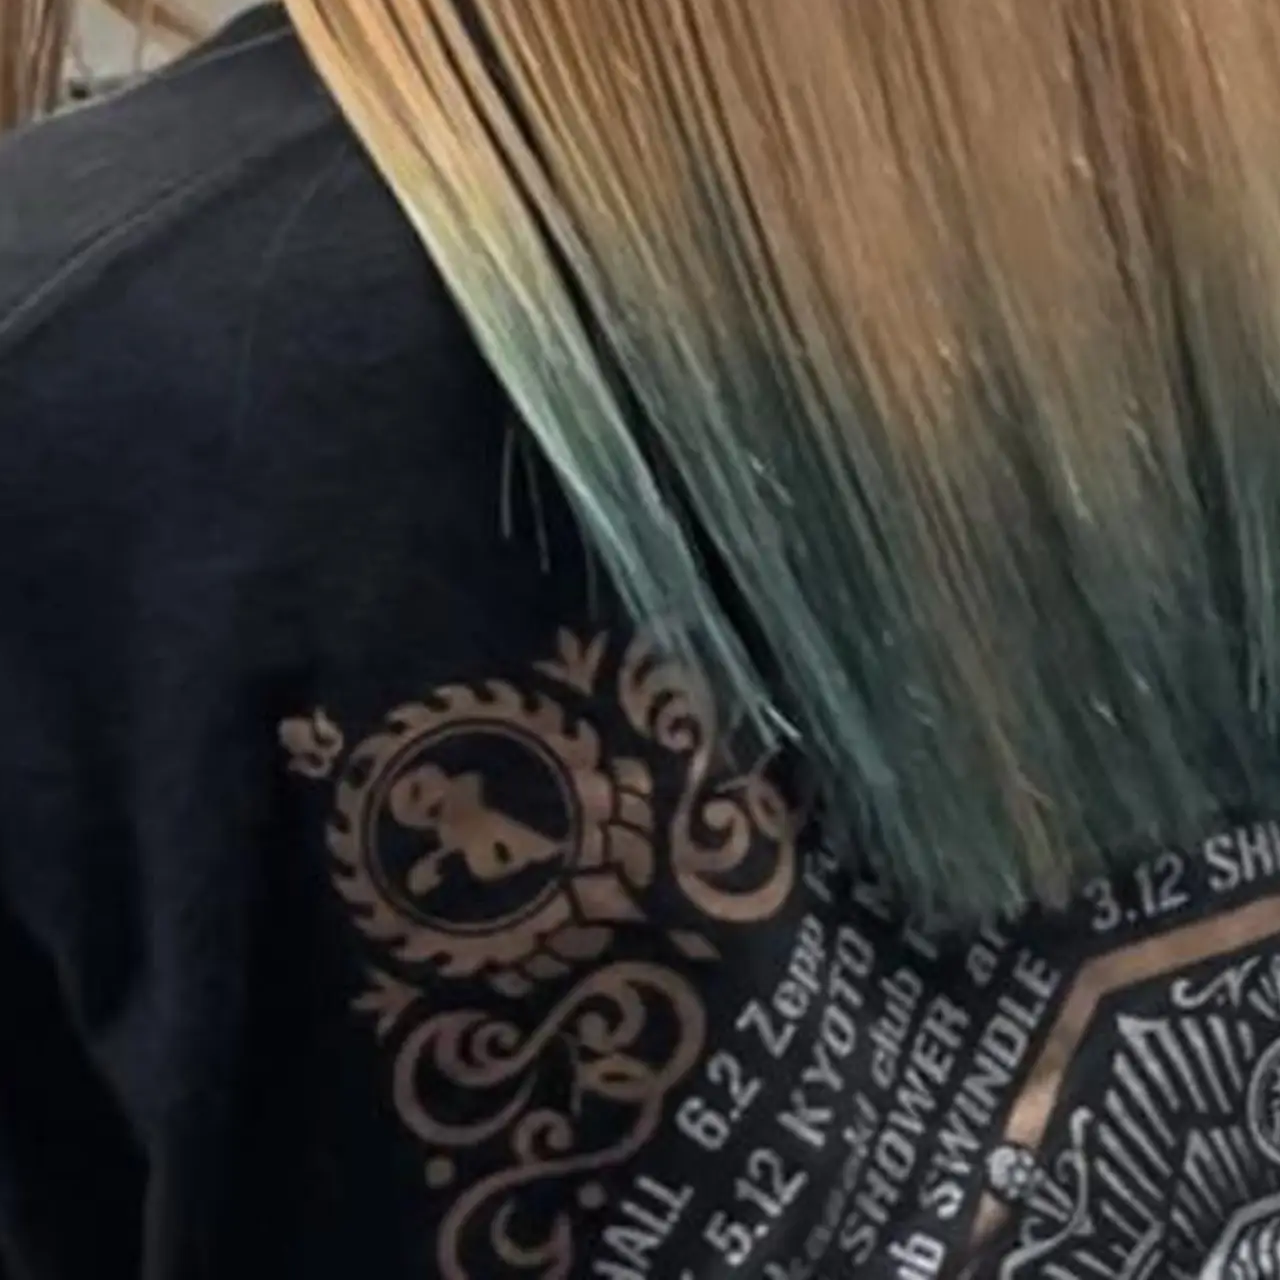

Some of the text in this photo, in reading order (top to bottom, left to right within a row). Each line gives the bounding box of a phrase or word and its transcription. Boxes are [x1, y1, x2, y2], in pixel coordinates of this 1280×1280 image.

[674, 1049, 762, 1151] 6.2
[703, 1146, 808, 1267] 5.12
[777, 925, 875, 1146] KYOTO
[838, 993, 971, 1268] SHOWER
